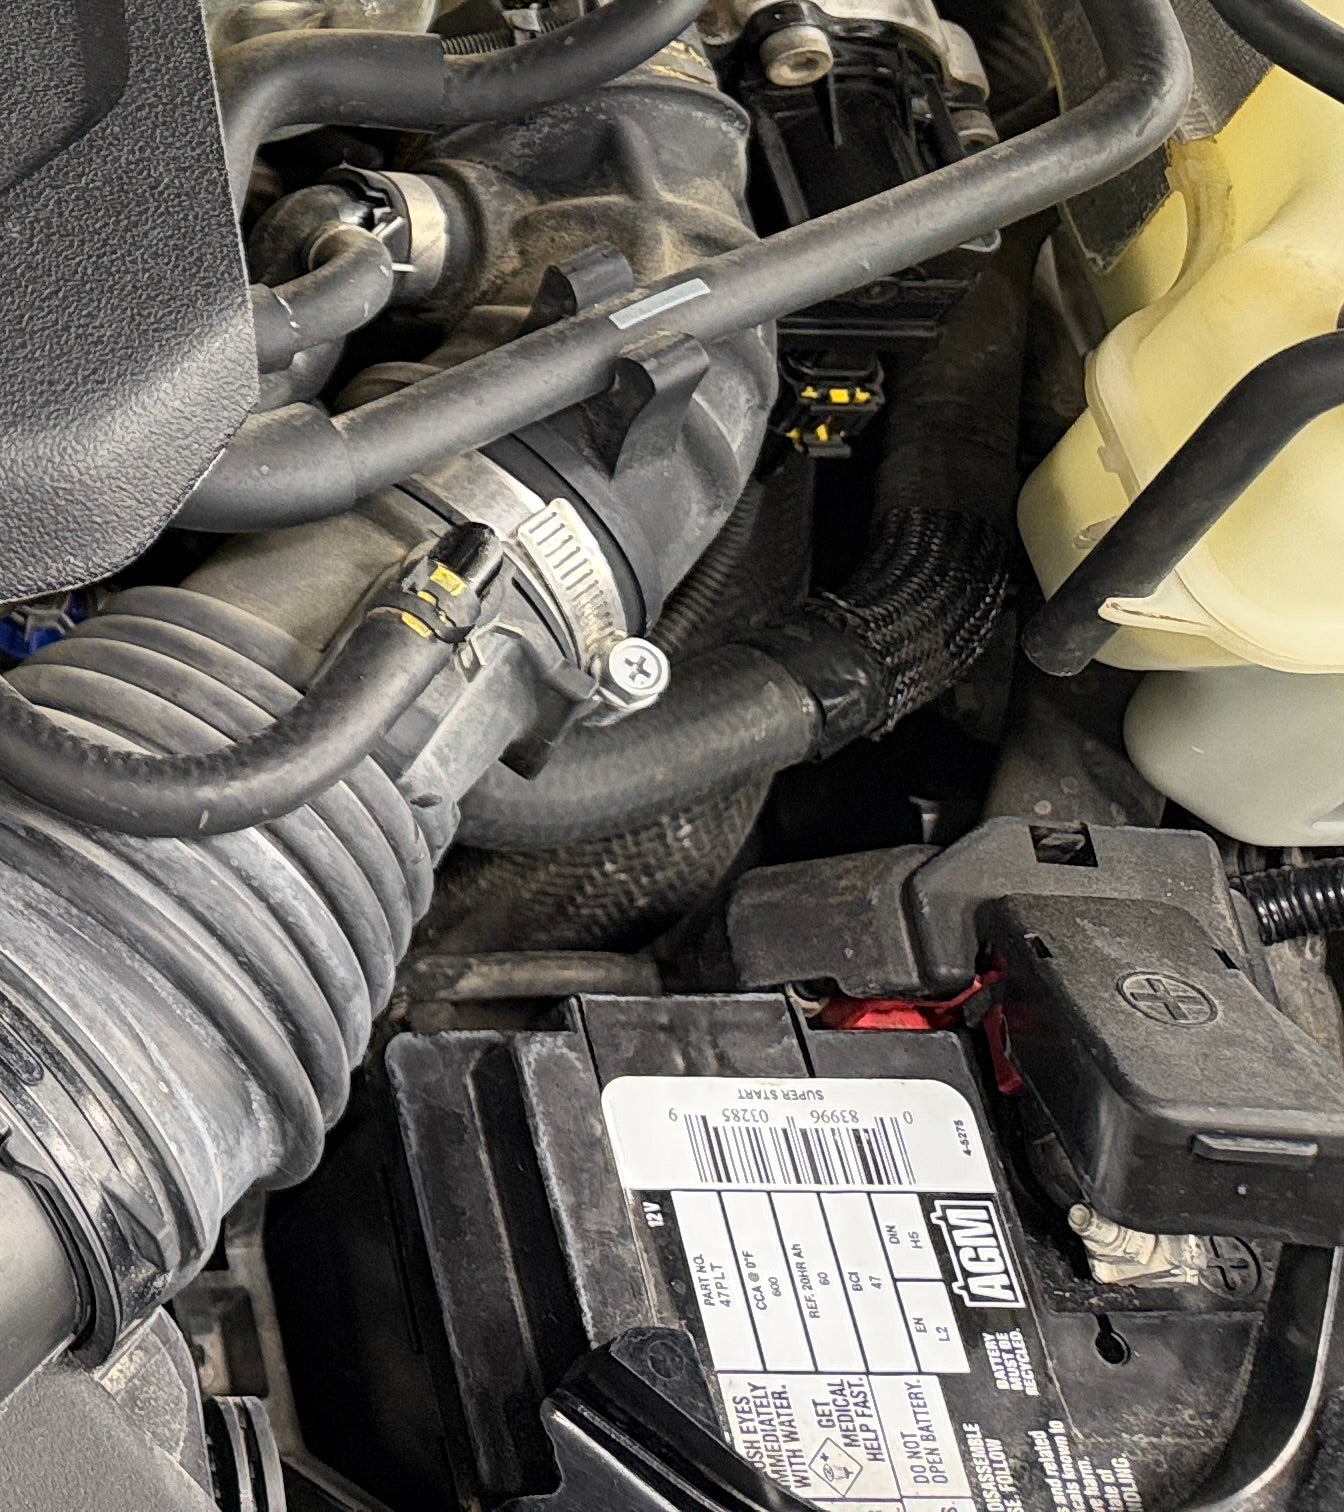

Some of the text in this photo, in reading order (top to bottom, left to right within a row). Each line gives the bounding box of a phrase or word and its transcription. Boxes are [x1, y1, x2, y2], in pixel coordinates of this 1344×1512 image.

[738, 1088, 825, 1101] SUPER START
[721, 1107, 770, 1123] 03285
[810, 1109, 860, 1124] 83996
[902, 1110, 914, 1125] 0
[642, 1201, 665, 1228] 12V
[885, 1224, 901, 1245] DIN
[907, 1231, 923, 1250] H5
[944, 1207, 1017, 1302] AGM
[692, 1253, 716, 1307] PART NO.
[767, 1276, 782, 1297] 600
[791, 1243, 821, 1319] REF. 20HR Ah
[817, 1271, 830, 1286] 60
[847, 1271, 864, 1292] BCI
[868, 1275, 883, 1290] 47
[750, 1285, 768, 1311] CCA
[912, 1317, 928, 1334] EN
[935, 1326, 951, 1342] L2
[981, 1332, 1010, 1390] BATTERY
[1000, 1351, 1025, 1391] MUST
[732, 1395, 759, 1435] EYES
[812, 1398, 837, 1429] GET
[826, 1378, 862, 1448] MEDICAL
[846, 1377, 886, 1463] HELP FAST.
[771, 1384, 812, 1489] WITH WATER.
[904, 1377, 949, 1485] OPEN BATTERY.
[900, 1431, 931, 1485] DO NOT
[962, 1422, 1005, 1512] DISASSEMBLE
[984, 1438, 1018, 1493] FOLLOW
[1027, 1430, 1061, 1477] related
[1053, 1435, 1078, 1480] known
[1045, 1477, 1068, 1506] and
[1110, 1452, 1144, 1512] NDLING.
